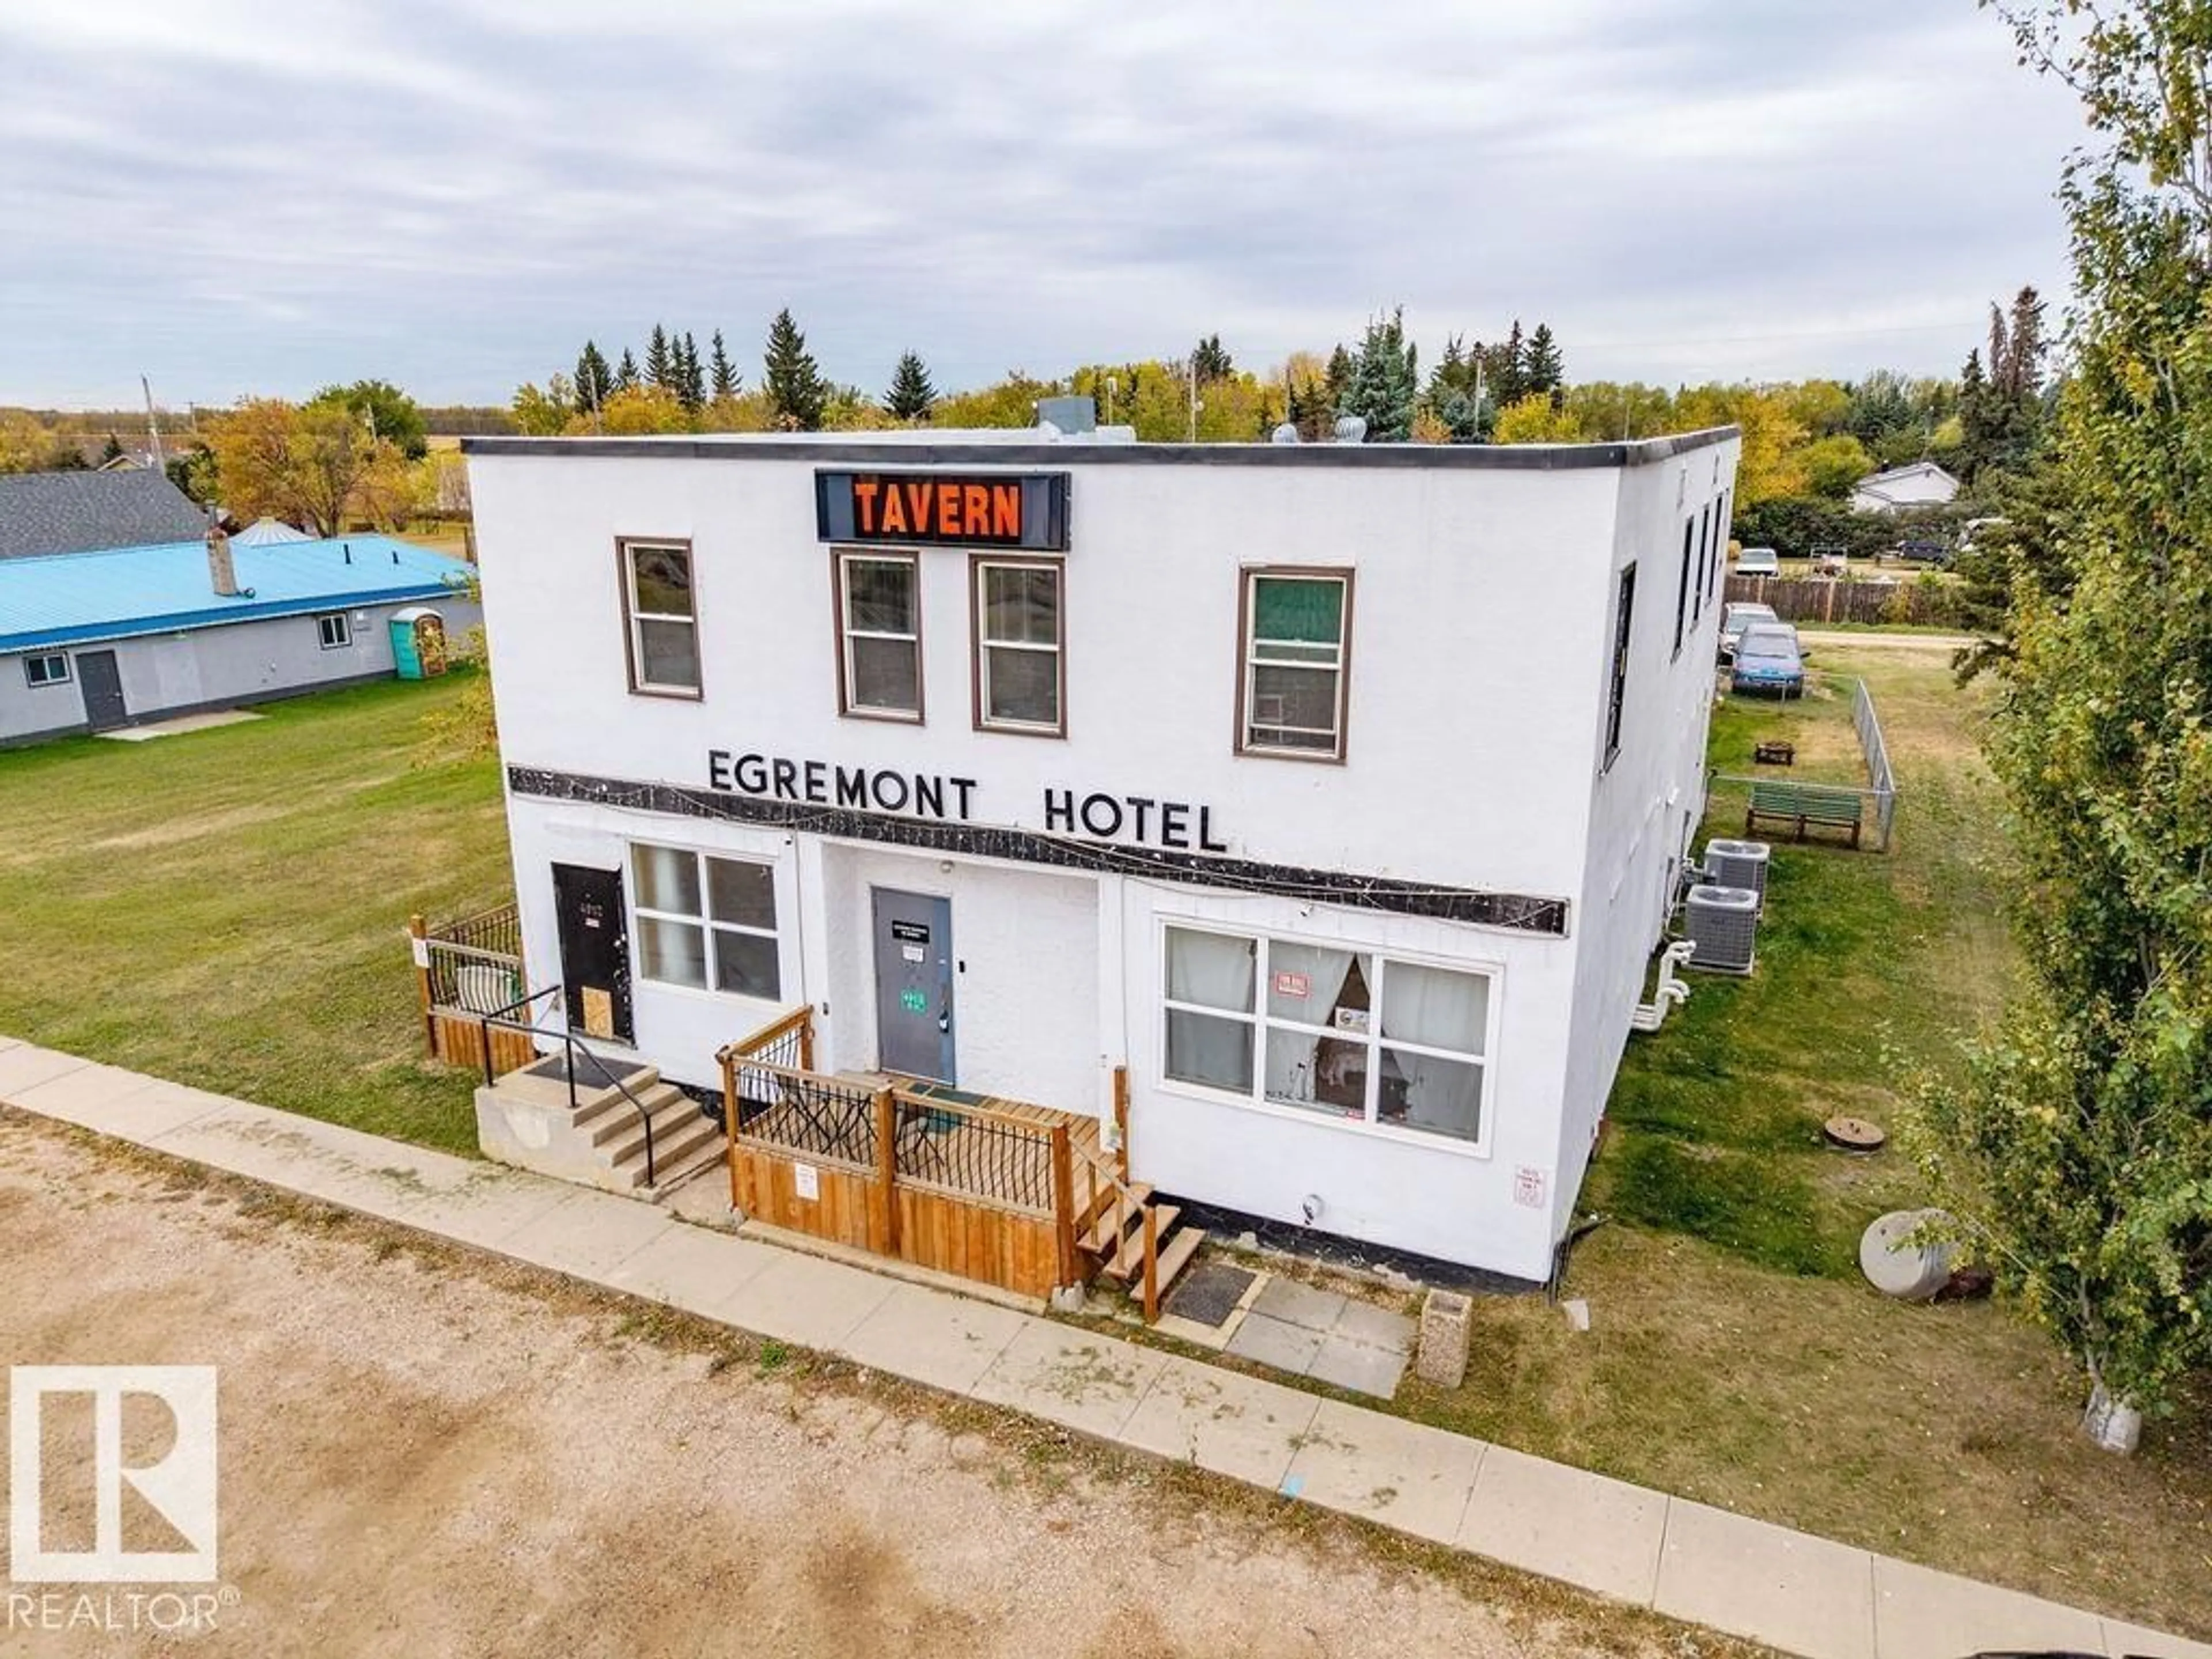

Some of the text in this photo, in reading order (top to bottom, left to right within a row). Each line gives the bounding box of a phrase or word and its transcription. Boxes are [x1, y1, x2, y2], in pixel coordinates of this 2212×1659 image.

[855, 483, 1019, 537] TAVERN
[709, 749, 1226, 852] EGREMONT HOTEL
